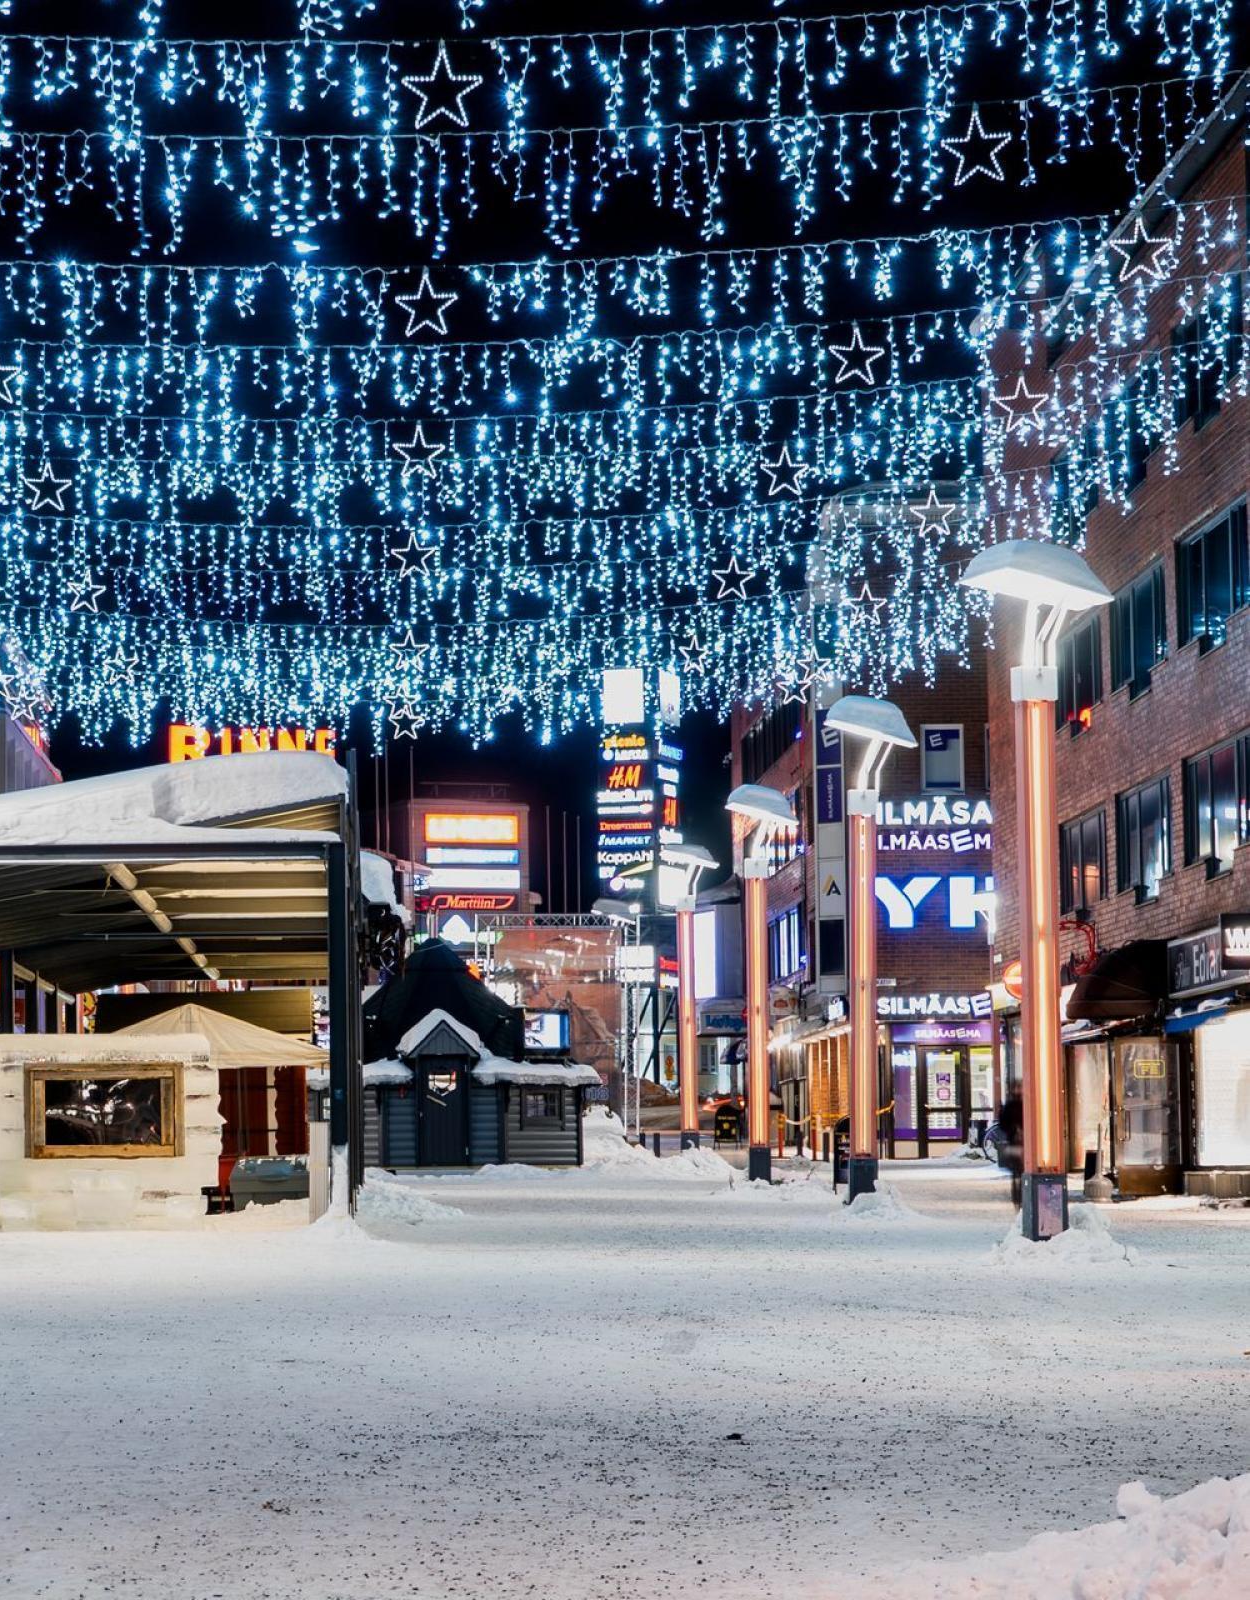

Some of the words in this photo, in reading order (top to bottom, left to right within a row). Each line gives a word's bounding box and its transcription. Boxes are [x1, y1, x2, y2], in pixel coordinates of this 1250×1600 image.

[608, 765, 641, 788] H&M
[875, 796, 994, 825] ILMÄSA
[877, 829, 992, 853] LMÄASEM
[597, 850, 654, 866] KappAhl
[914, 1027, 982, 1040] SILMÄASEMA
